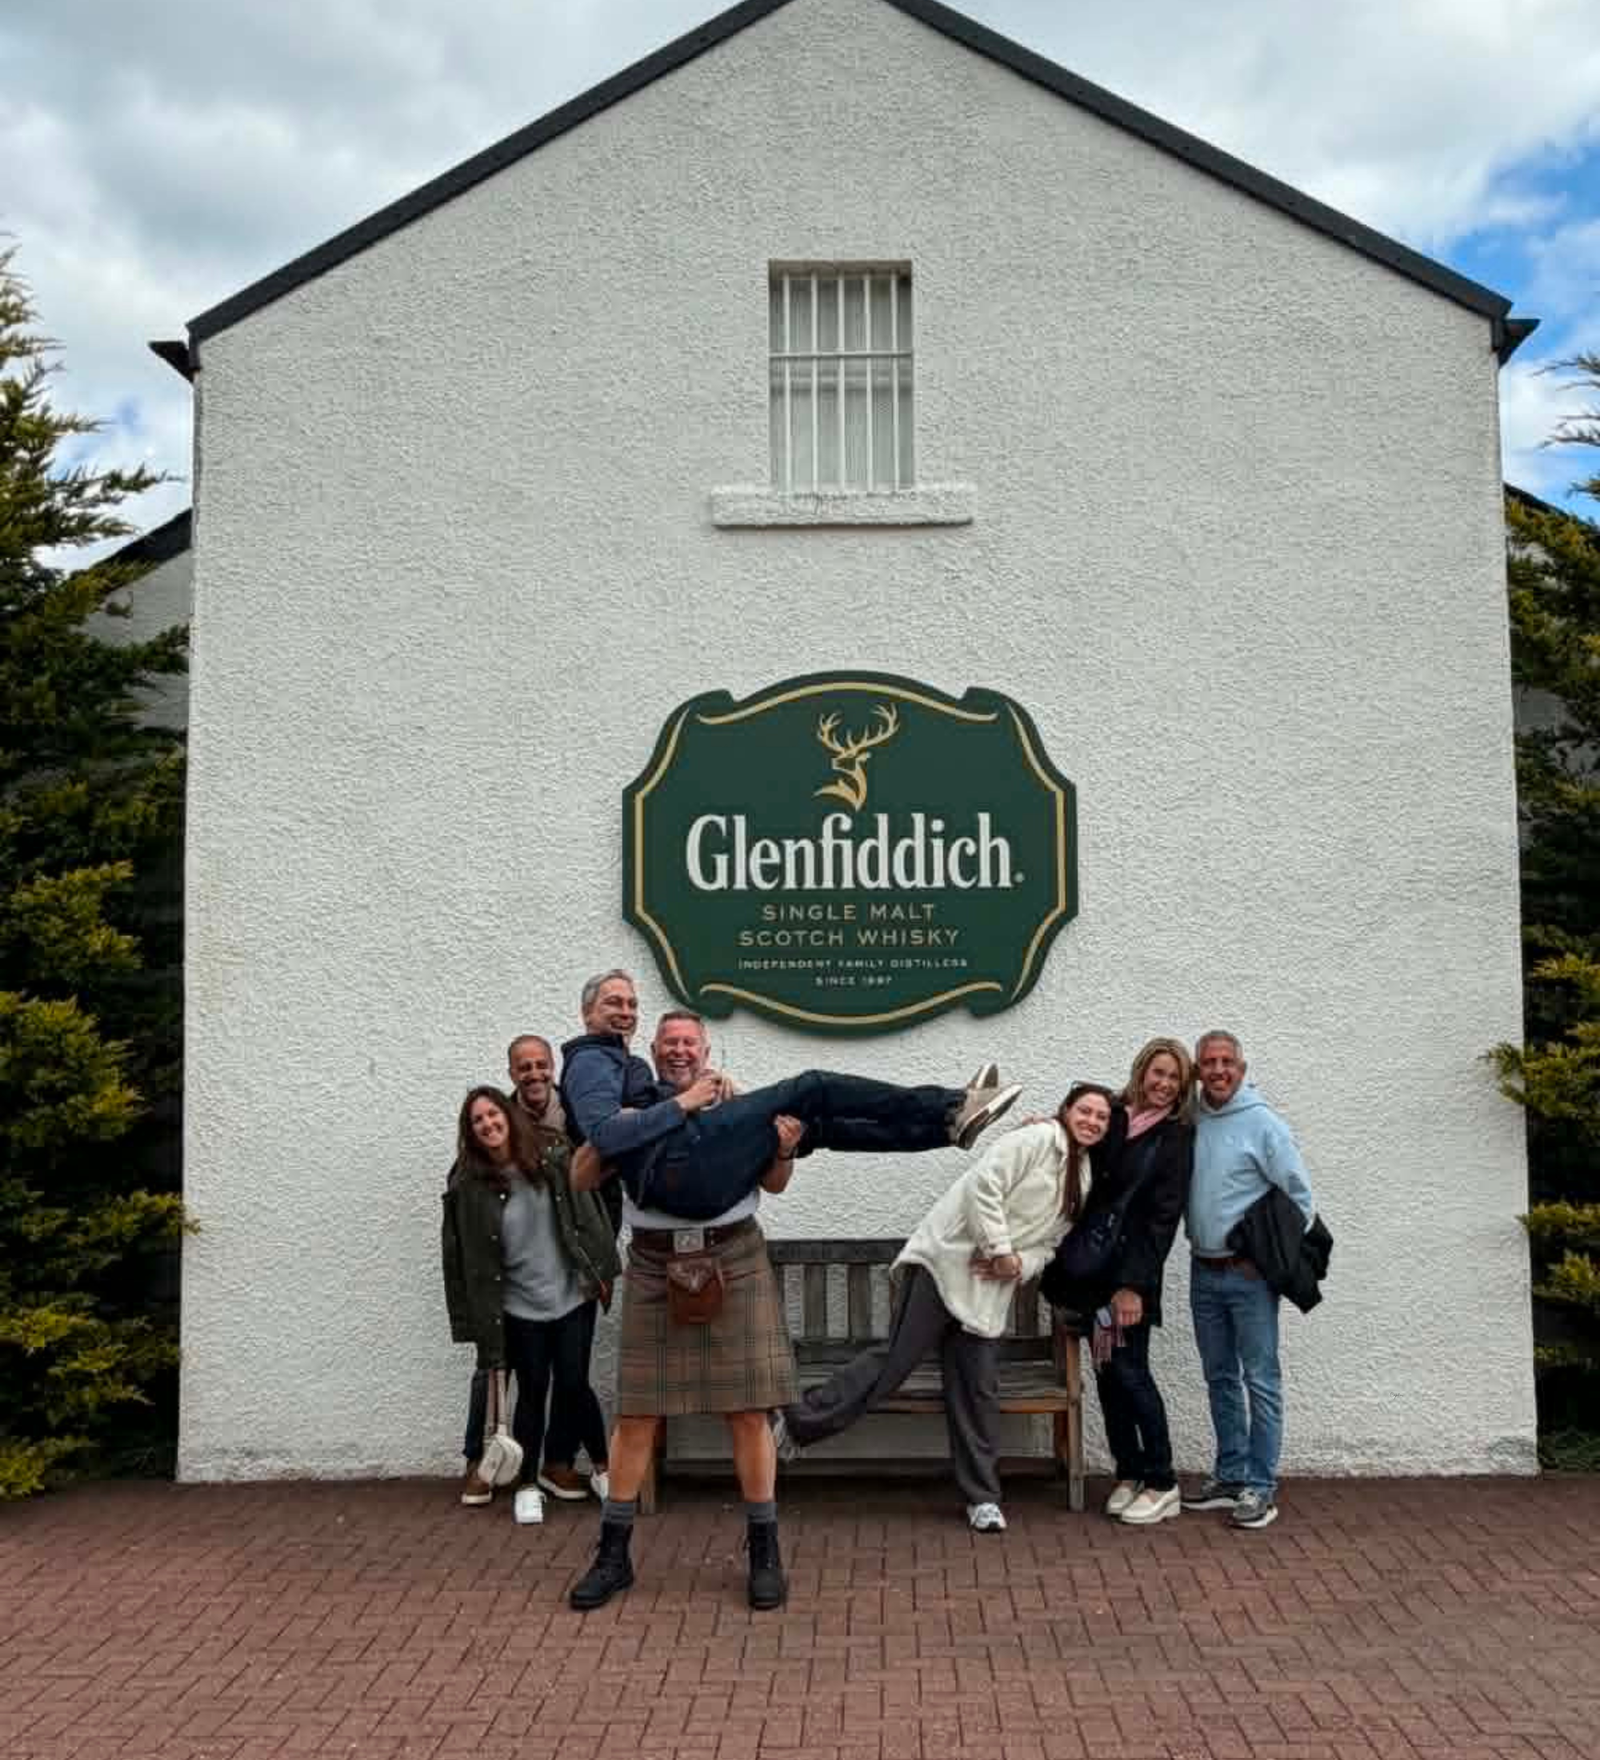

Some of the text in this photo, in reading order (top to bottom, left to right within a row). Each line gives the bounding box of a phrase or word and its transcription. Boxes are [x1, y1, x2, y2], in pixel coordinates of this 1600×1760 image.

[761, 903, 935, 921] SINGLE MALT
[738, 929, 960, 947] SCOTCH WHISKY
[815, 976, 856, 987] SINCE
